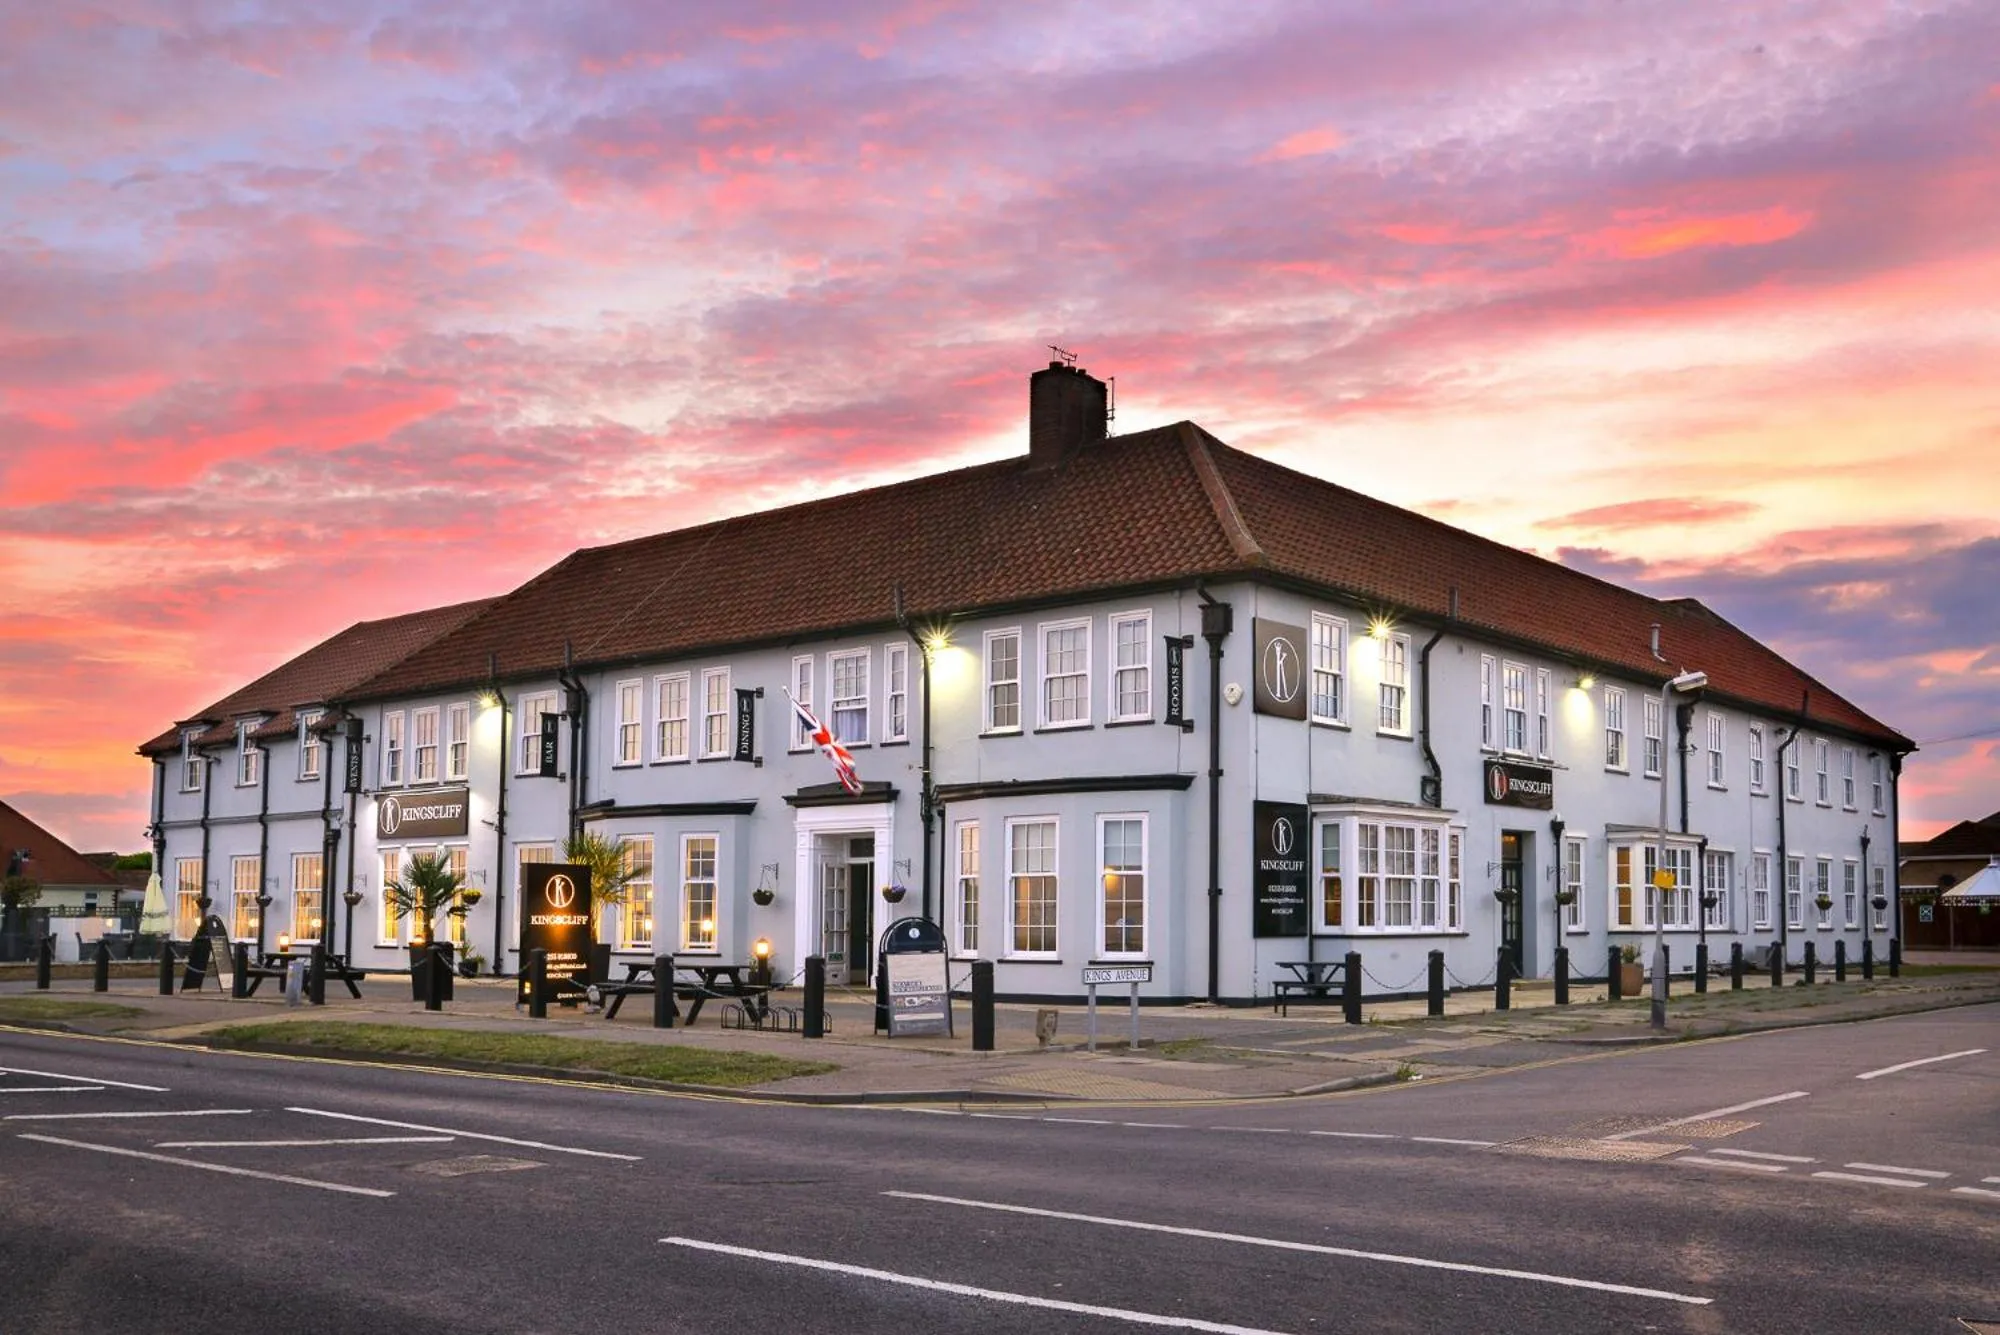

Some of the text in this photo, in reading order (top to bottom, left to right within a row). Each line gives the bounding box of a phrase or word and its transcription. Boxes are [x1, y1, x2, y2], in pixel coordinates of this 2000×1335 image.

[1171, 667, 1179, 715] ROOMS
[741, 714, 750, 754] DINING
[1509, 778, 1552, 794] KINGSCLIFF
[402, 804, 462, 821] KINGSCLIFF
[1260, 860, 1305, 871] KINGSCLIFF
[531, 915, 588, 925] KINGSCLIFF
[1086, 969, 1147, 981] KINGS AVENUE
